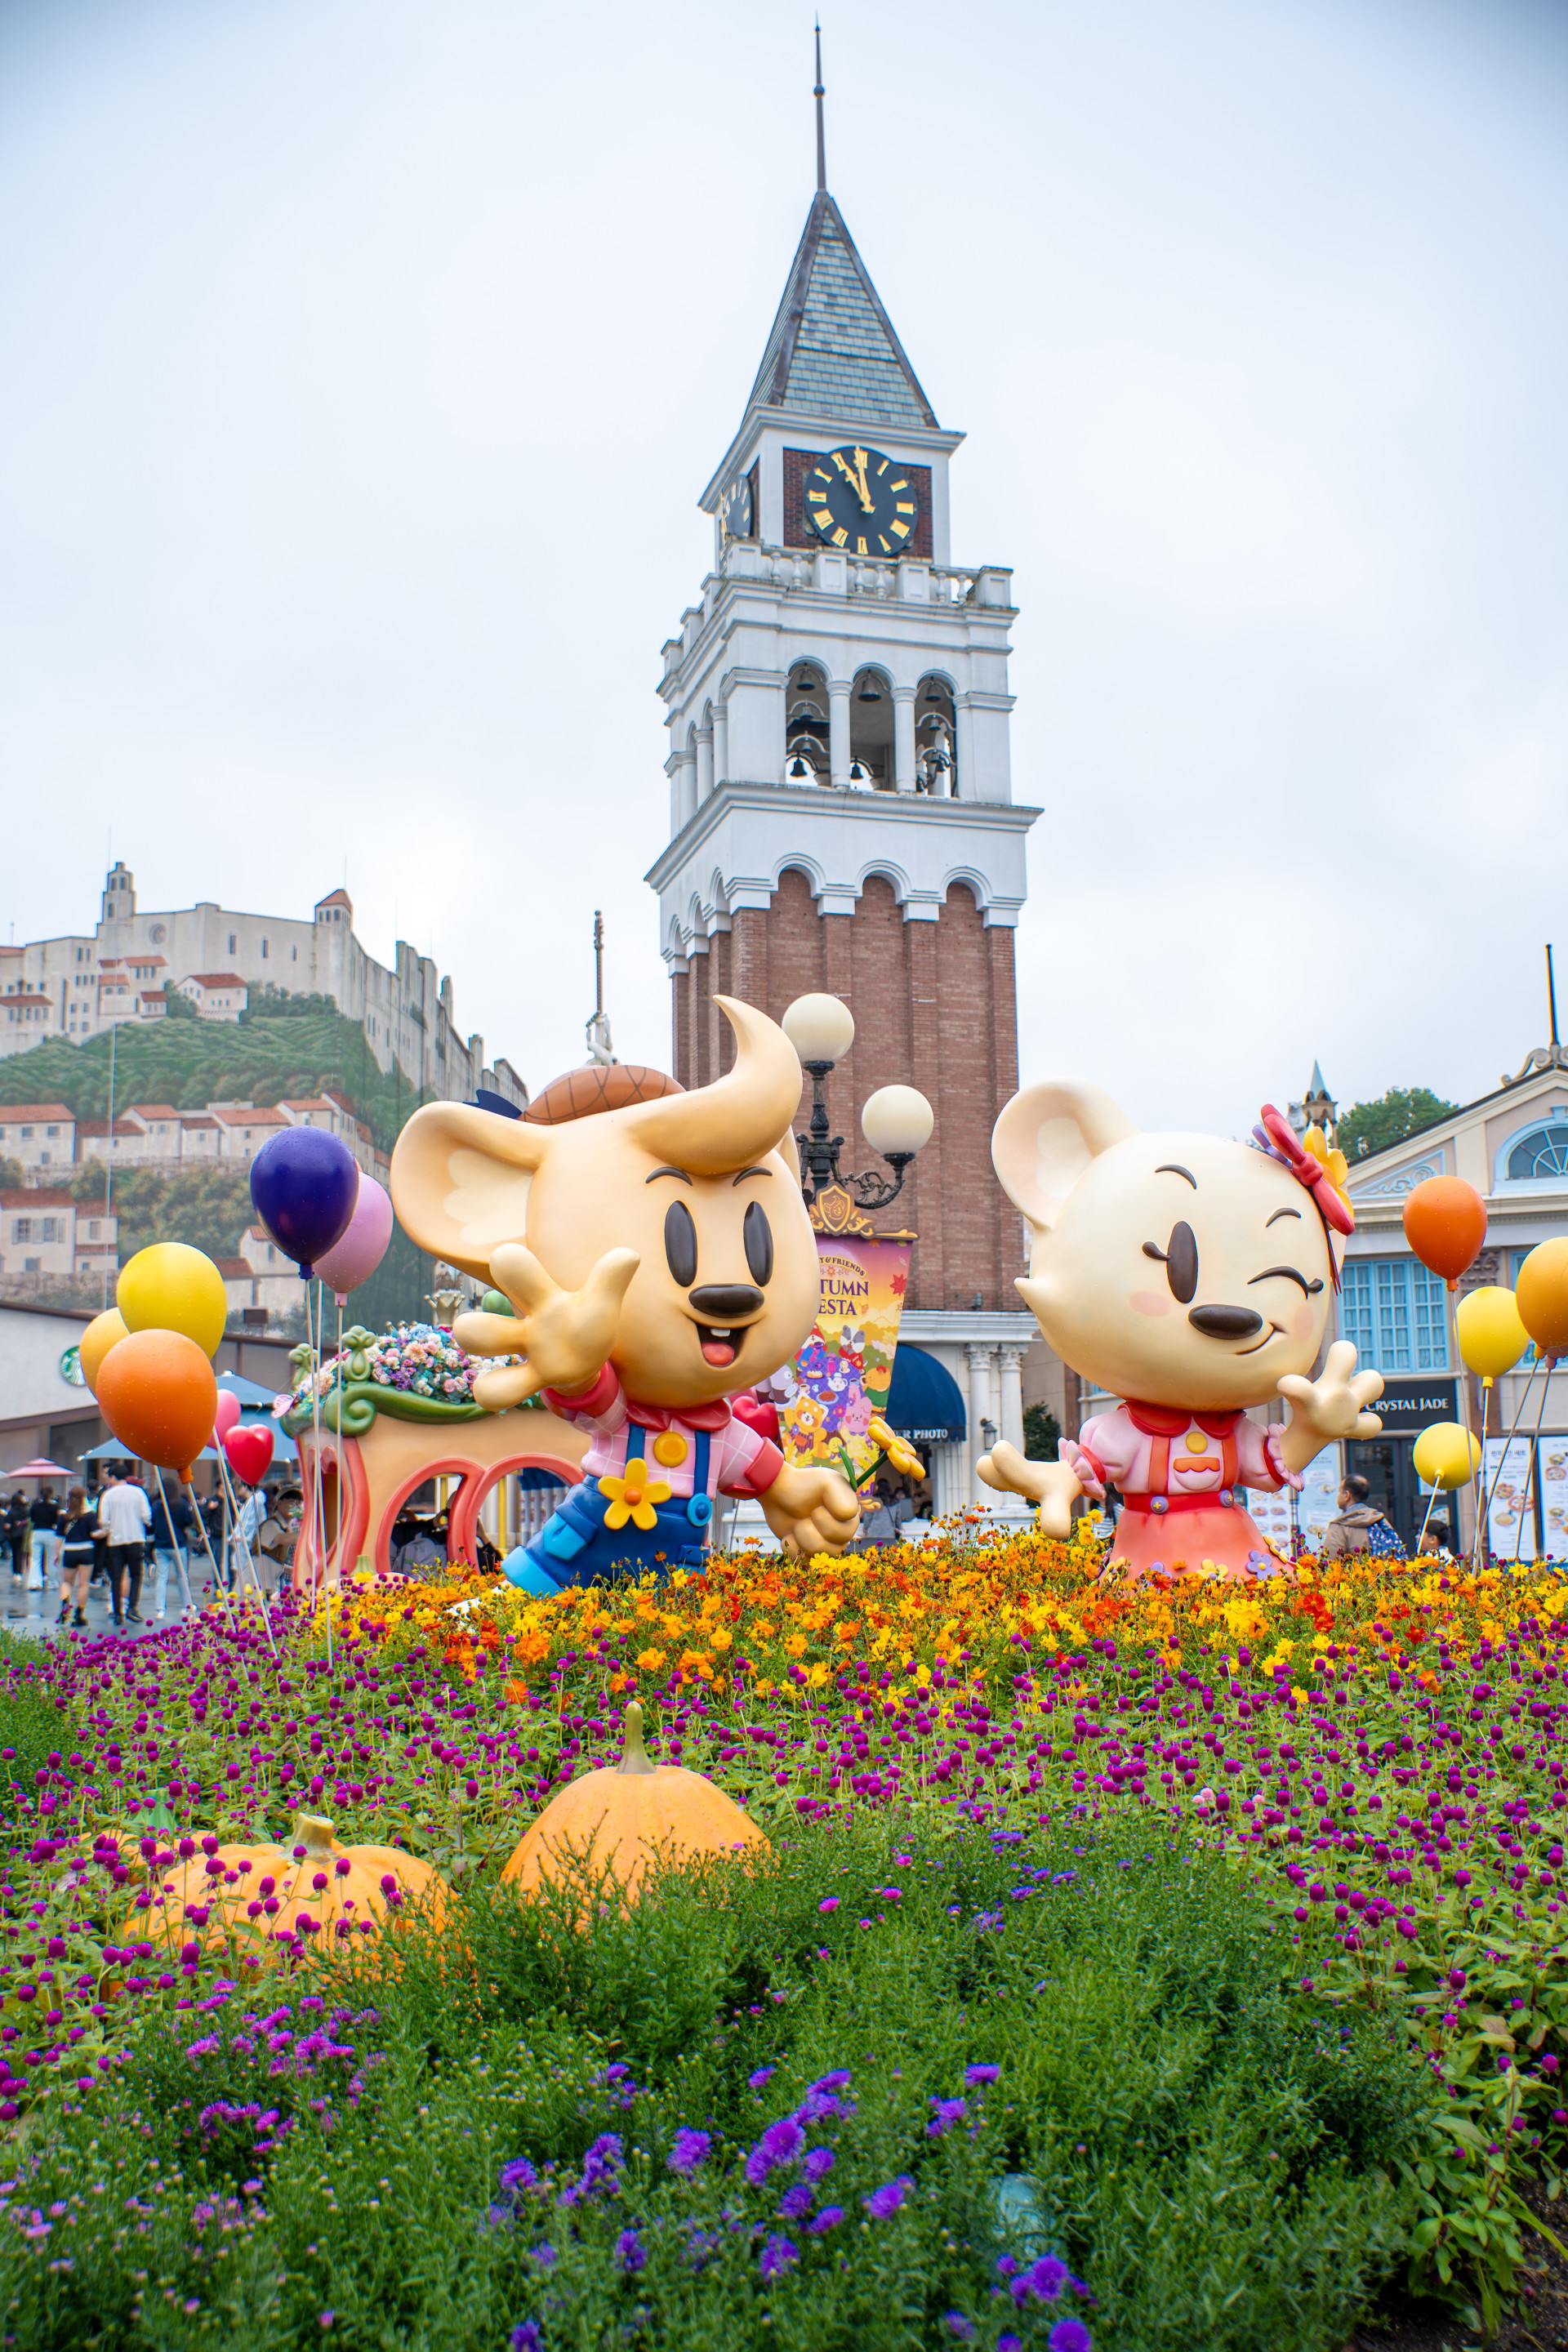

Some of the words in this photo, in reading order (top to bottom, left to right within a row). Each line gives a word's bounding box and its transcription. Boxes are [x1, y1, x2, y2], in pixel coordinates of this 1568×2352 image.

[820, 1279, 870, 1297] TUMN
[818, 1298, 858, 1316] ESTA
[1365, 1399, 1418, 1412] CRYSTAL
[1419, 1397, 1449, 1411] JADE
[894, 1429, 911, 1440] ER
[913, 1428, 949, 1440] PHOTO
